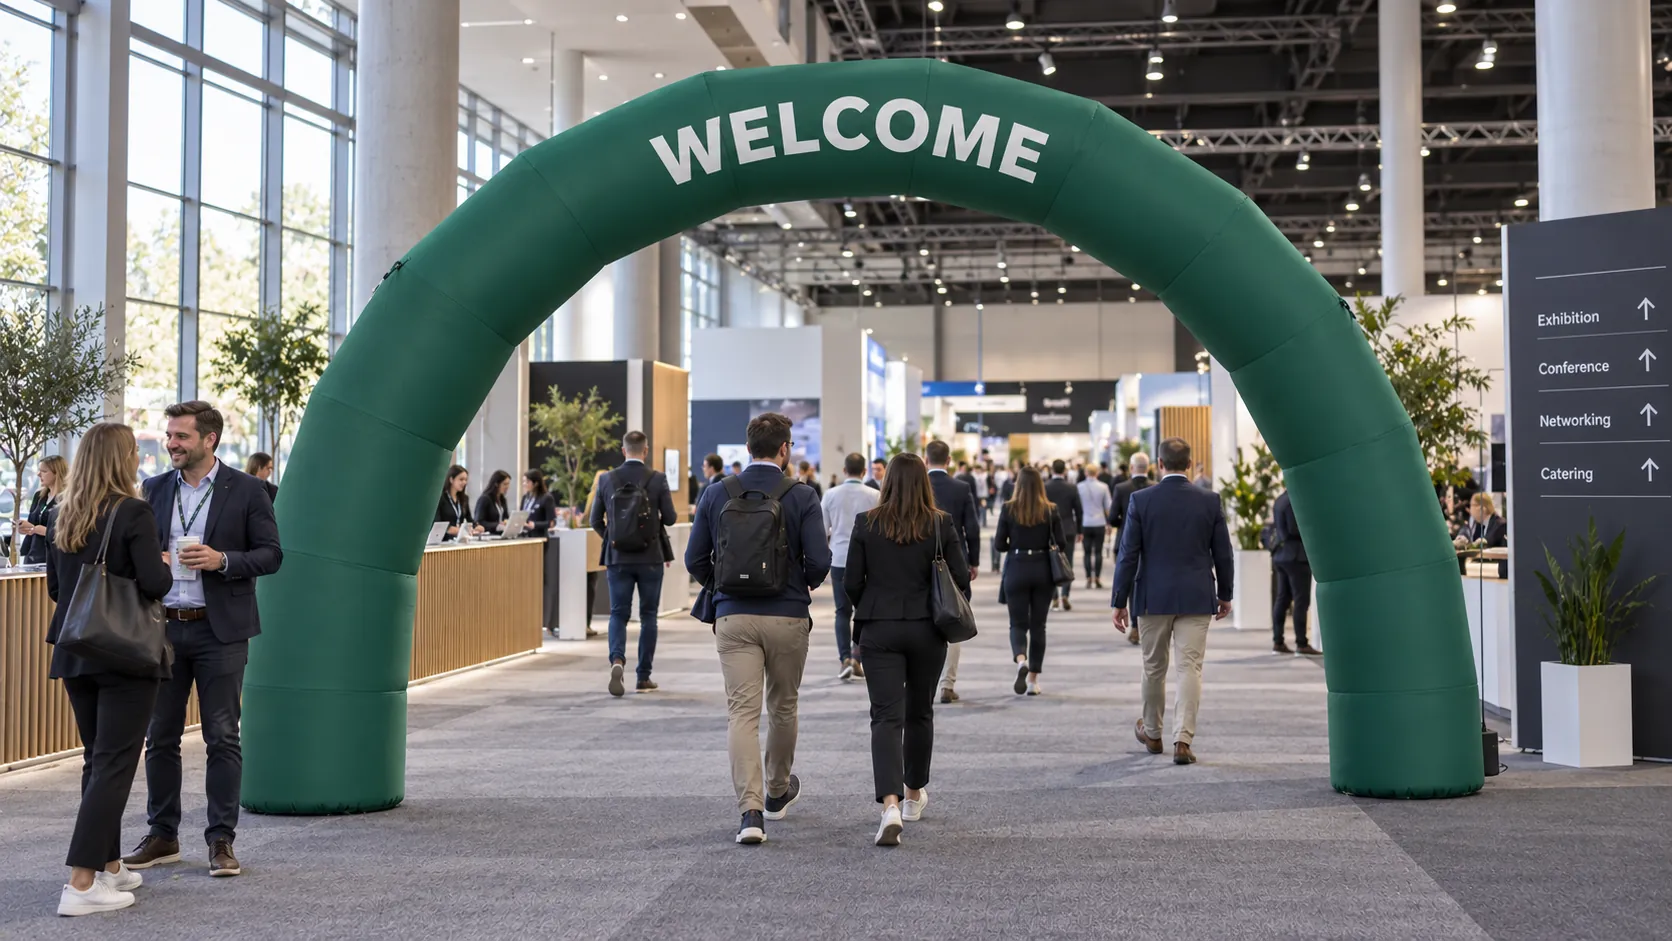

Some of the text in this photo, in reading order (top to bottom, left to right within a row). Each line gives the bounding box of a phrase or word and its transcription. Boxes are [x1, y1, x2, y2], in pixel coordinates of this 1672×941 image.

[649, 95, 1050, 185] WELCOME
[1538, 310, 1600, 327] Exhibition
[1538, 360, 1610, 376] Conference
[1539, 412, 1611, 429] Networking
[1540, 466, 1594, 483] Catering
